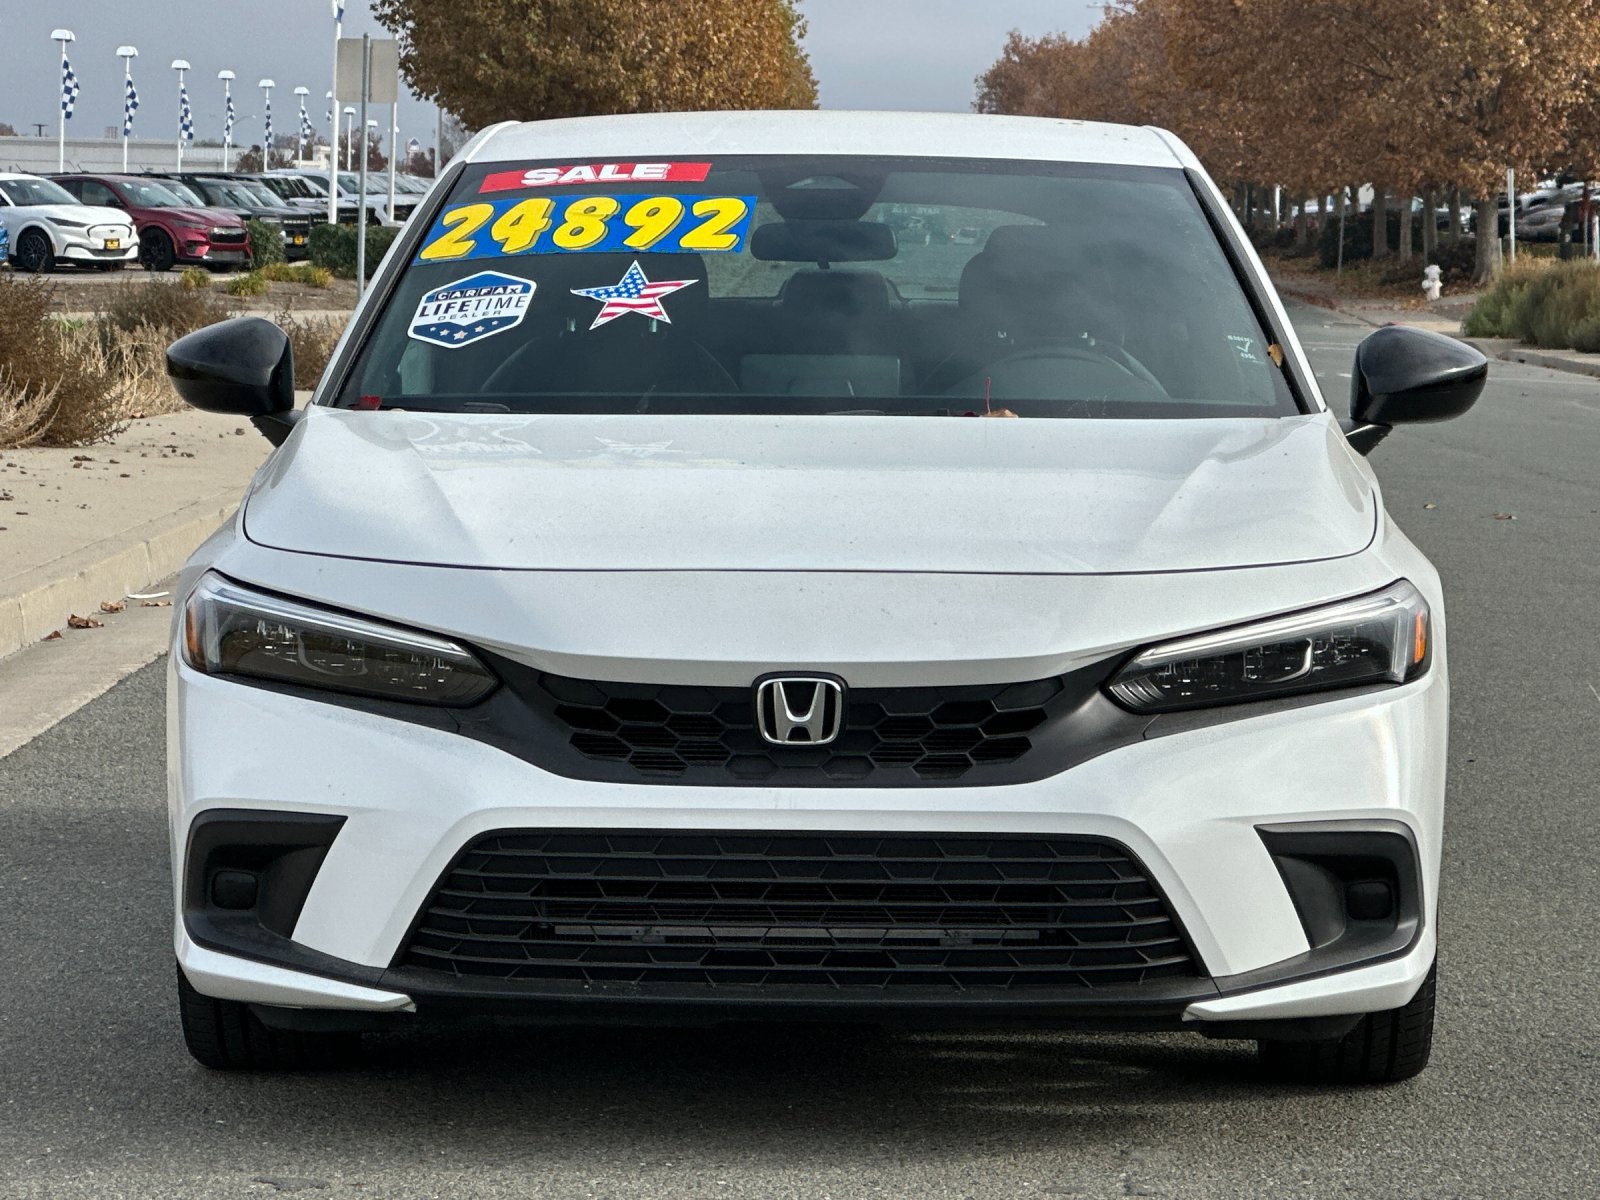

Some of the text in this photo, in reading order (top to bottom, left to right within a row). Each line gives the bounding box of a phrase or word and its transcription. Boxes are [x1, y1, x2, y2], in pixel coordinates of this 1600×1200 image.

[521, 163, 672, 186] SALE
[419, 196, 748, 260] 24892
[436, 285, 522, 301] CARFAX
[418, 295, 528, 318] LIFETIME
[437, 310, 502, 321] DEALER
